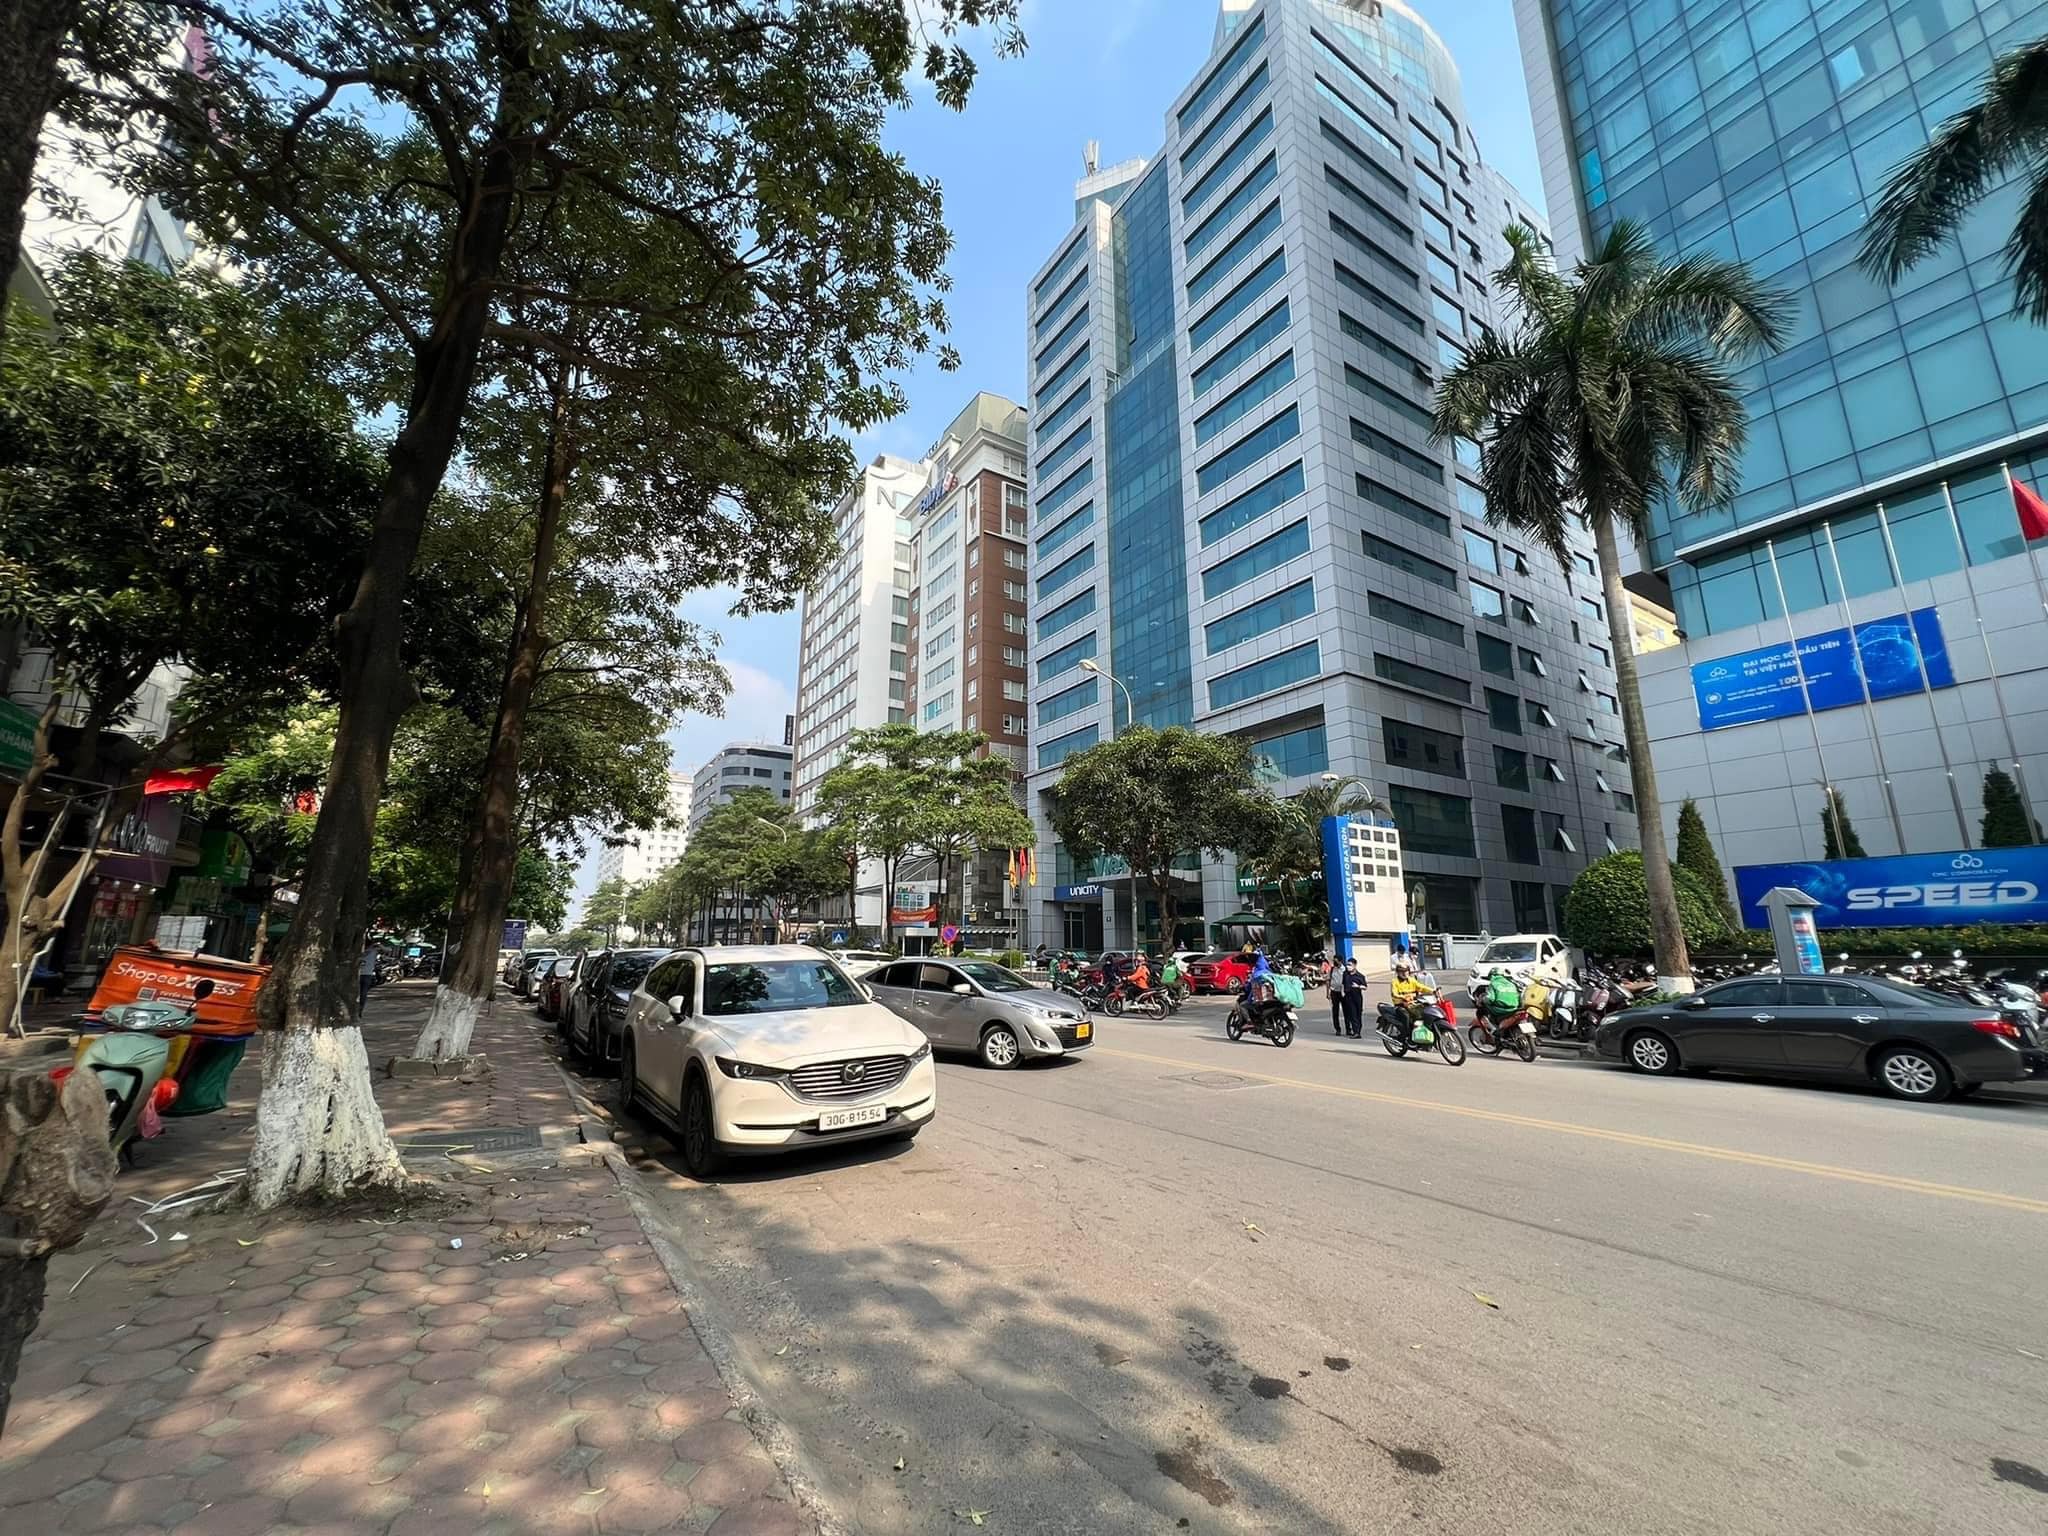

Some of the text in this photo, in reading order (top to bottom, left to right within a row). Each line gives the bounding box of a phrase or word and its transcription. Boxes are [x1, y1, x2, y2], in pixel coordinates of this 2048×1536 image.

[1069, 884, 1099, 897] UNICITY
[1846, 880, 2039, 910] SPEED
[113, 962, 178, 987] Shopee
